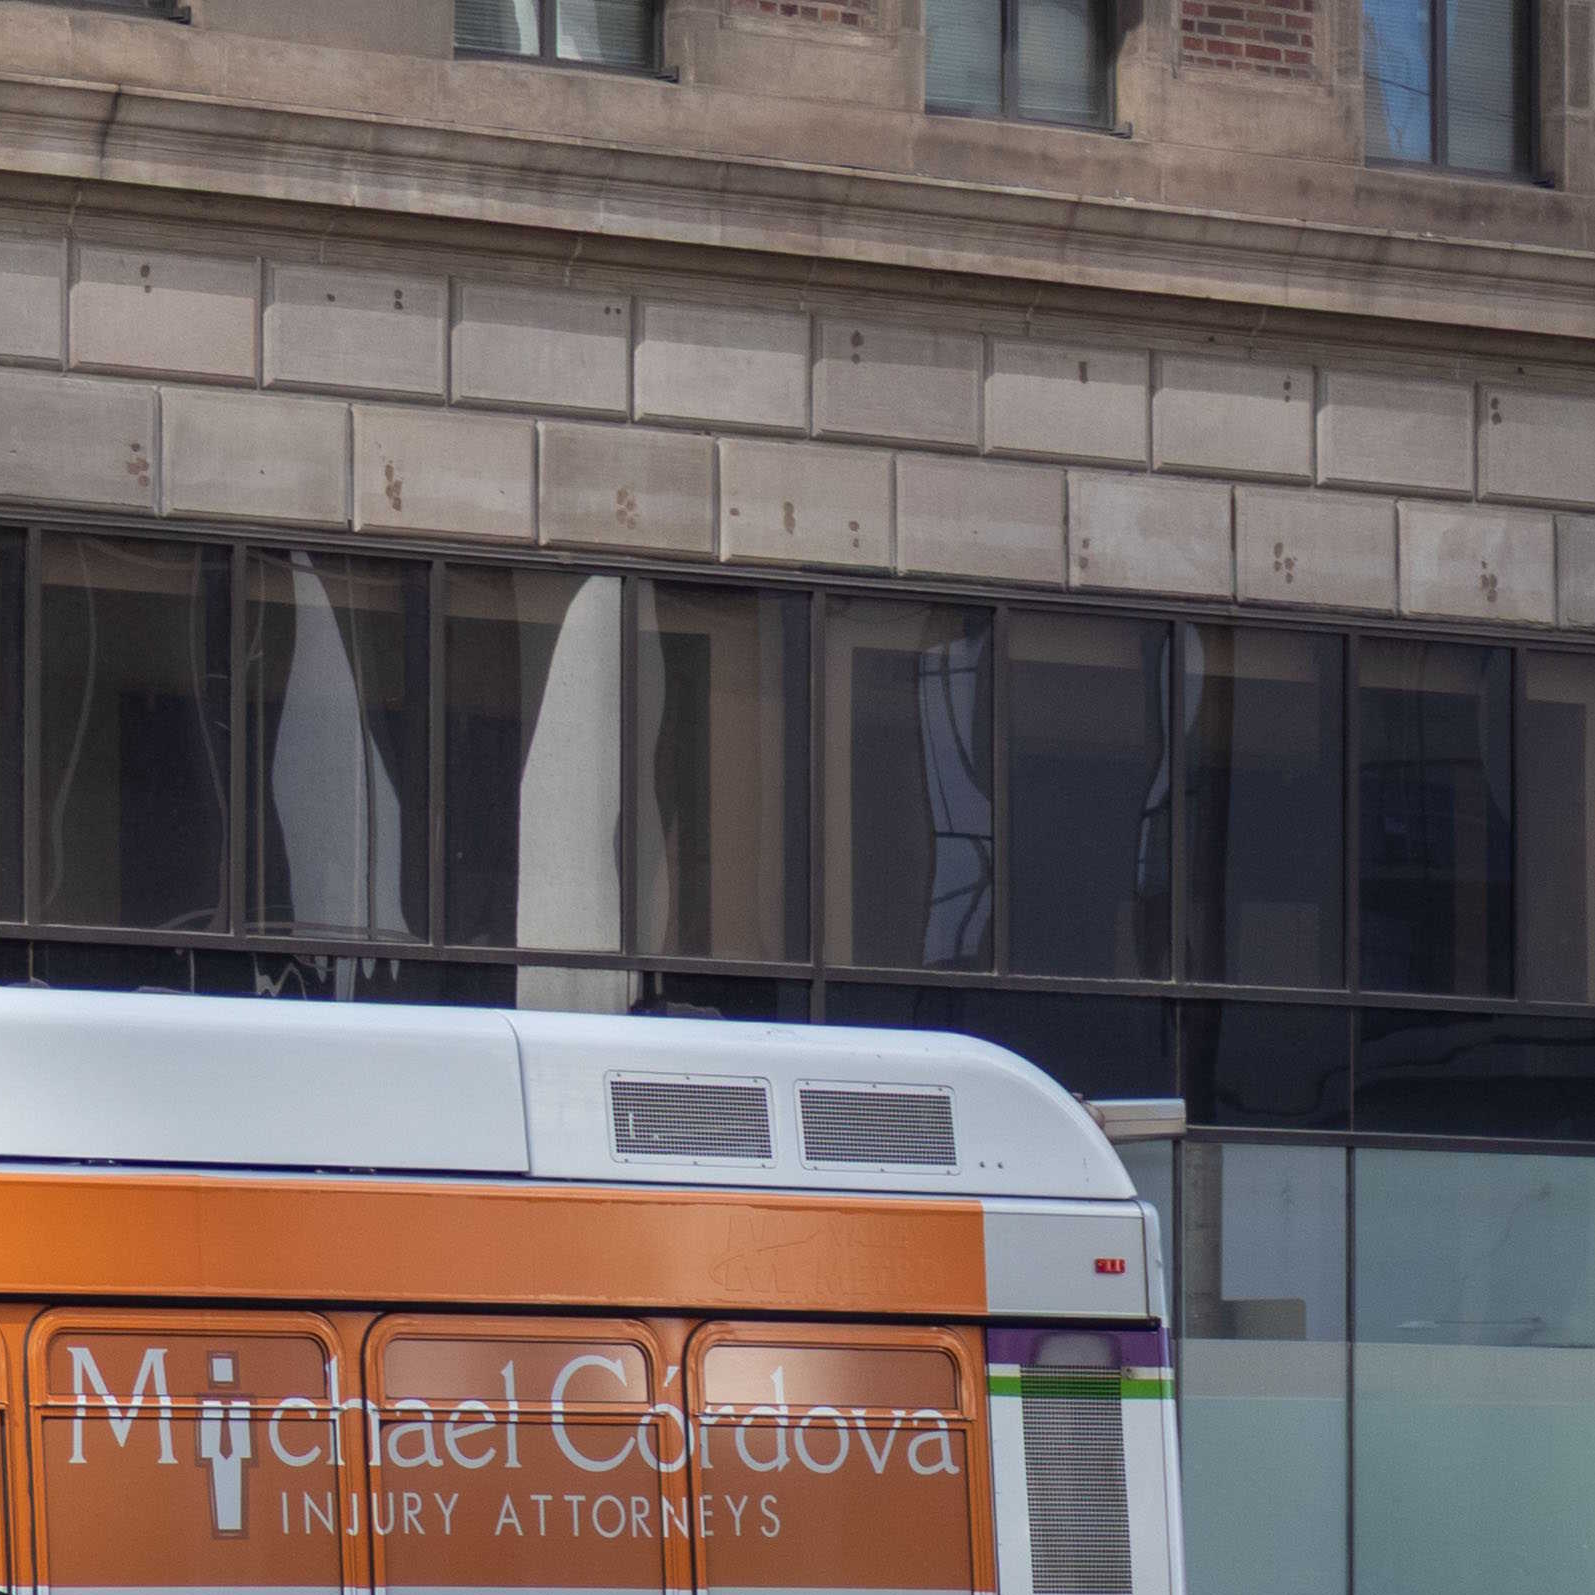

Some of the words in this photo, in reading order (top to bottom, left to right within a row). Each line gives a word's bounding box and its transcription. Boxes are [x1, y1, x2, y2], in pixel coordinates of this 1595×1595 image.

[66, 1345, 522, 1532] Michael
[550, 1353, 961, 1476] Córdova
[281, 1490, 460, 1537] INJURY
[494, 1493, 781, 1539] ATTORNEYS
